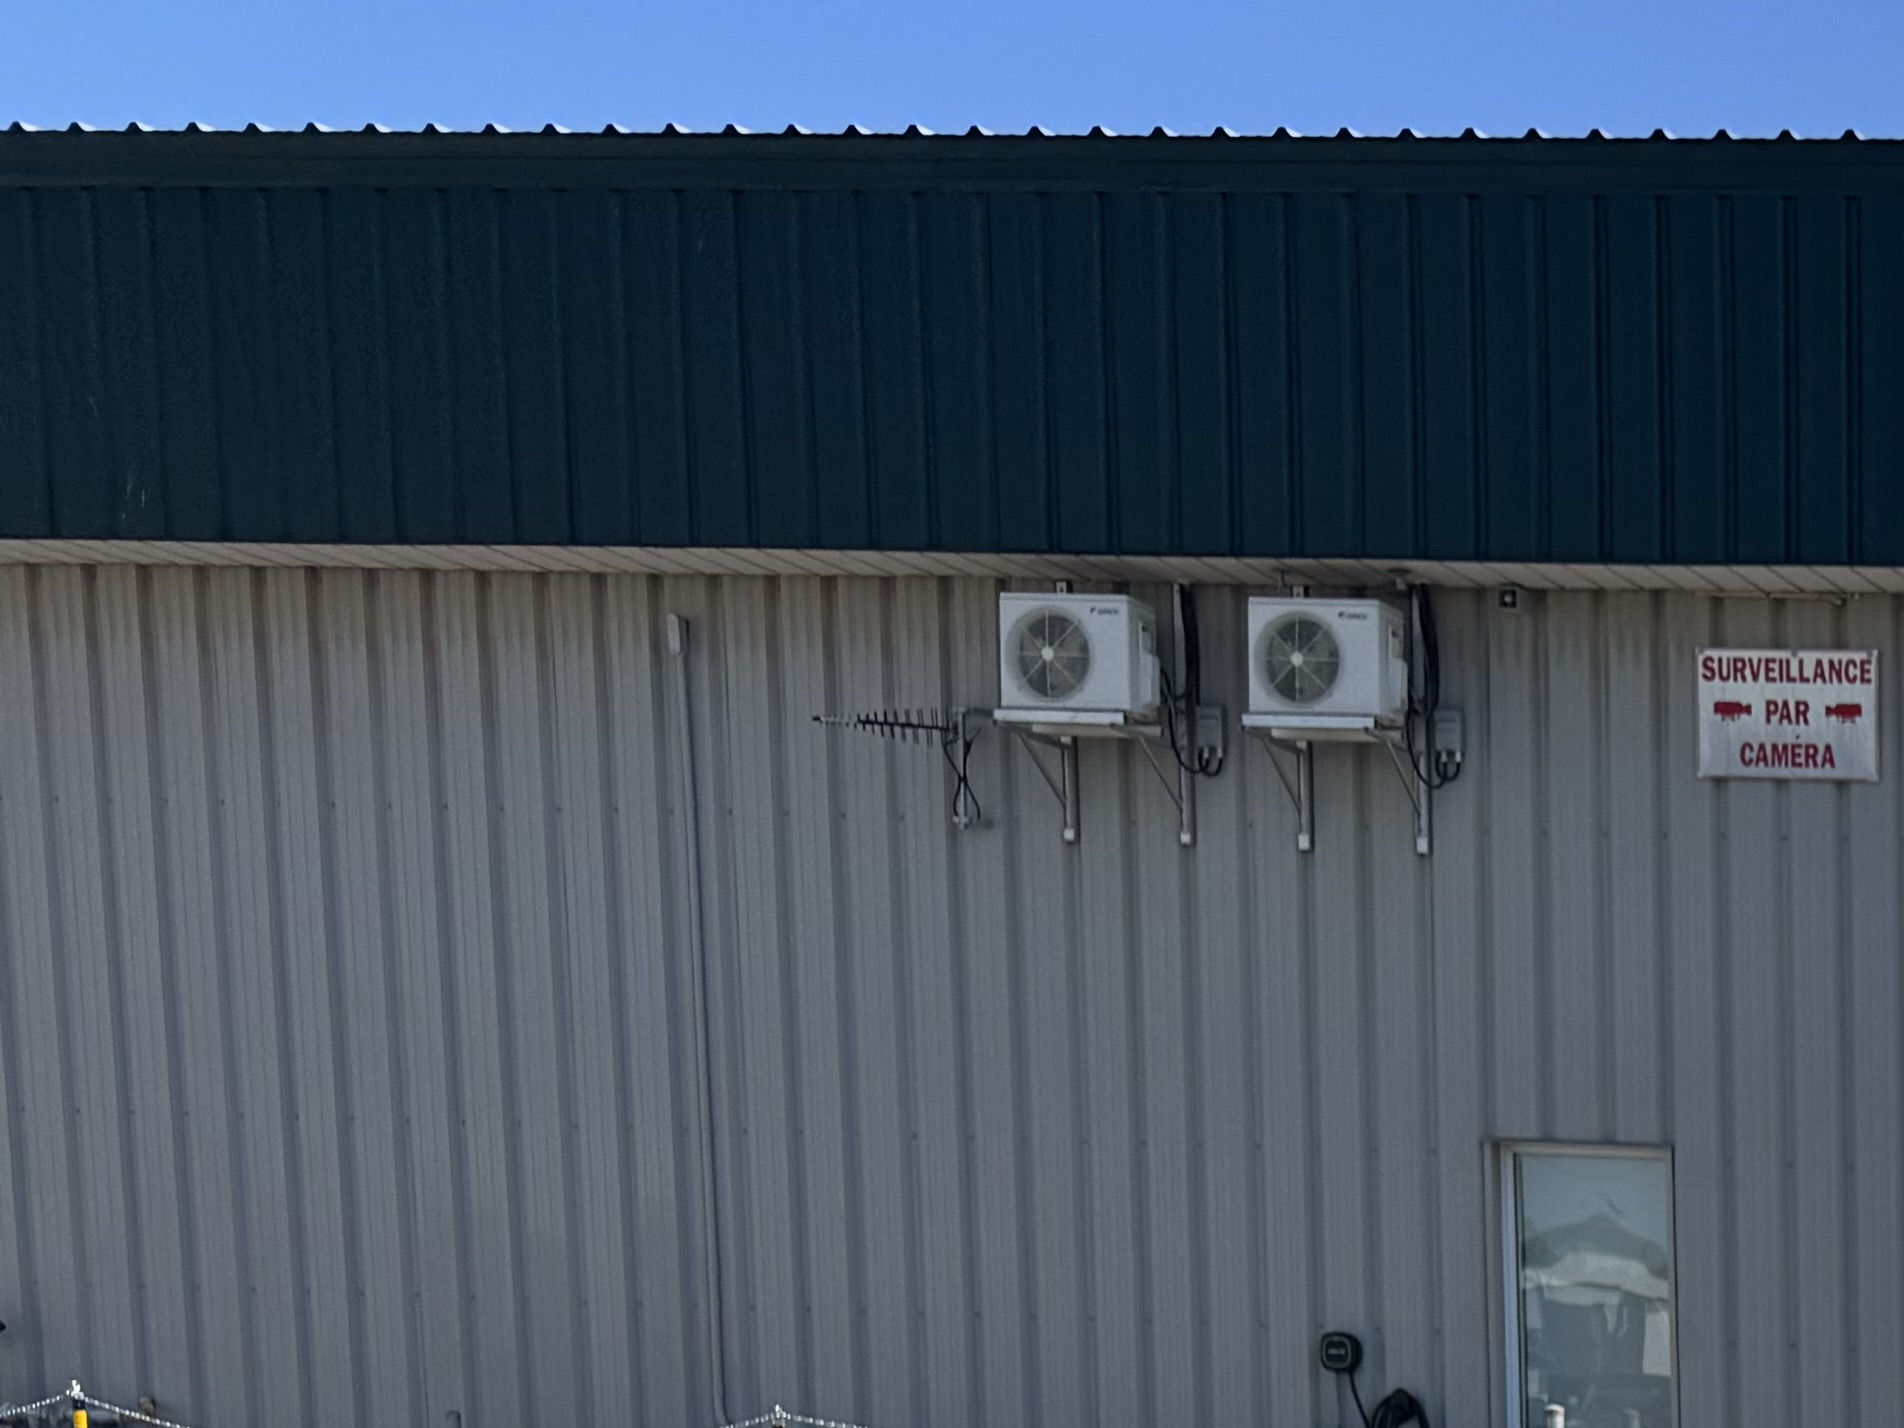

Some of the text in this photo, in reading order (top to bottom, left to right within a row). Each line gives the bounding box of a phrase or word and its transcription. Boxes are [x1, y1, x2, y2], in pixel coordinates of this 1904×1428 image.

[1702, 656, 1872, 684] SURVEILLANCE
[1765, 699, 1810, 726] PAR
[1740, 734, 1836, 769] CAMÉRA
